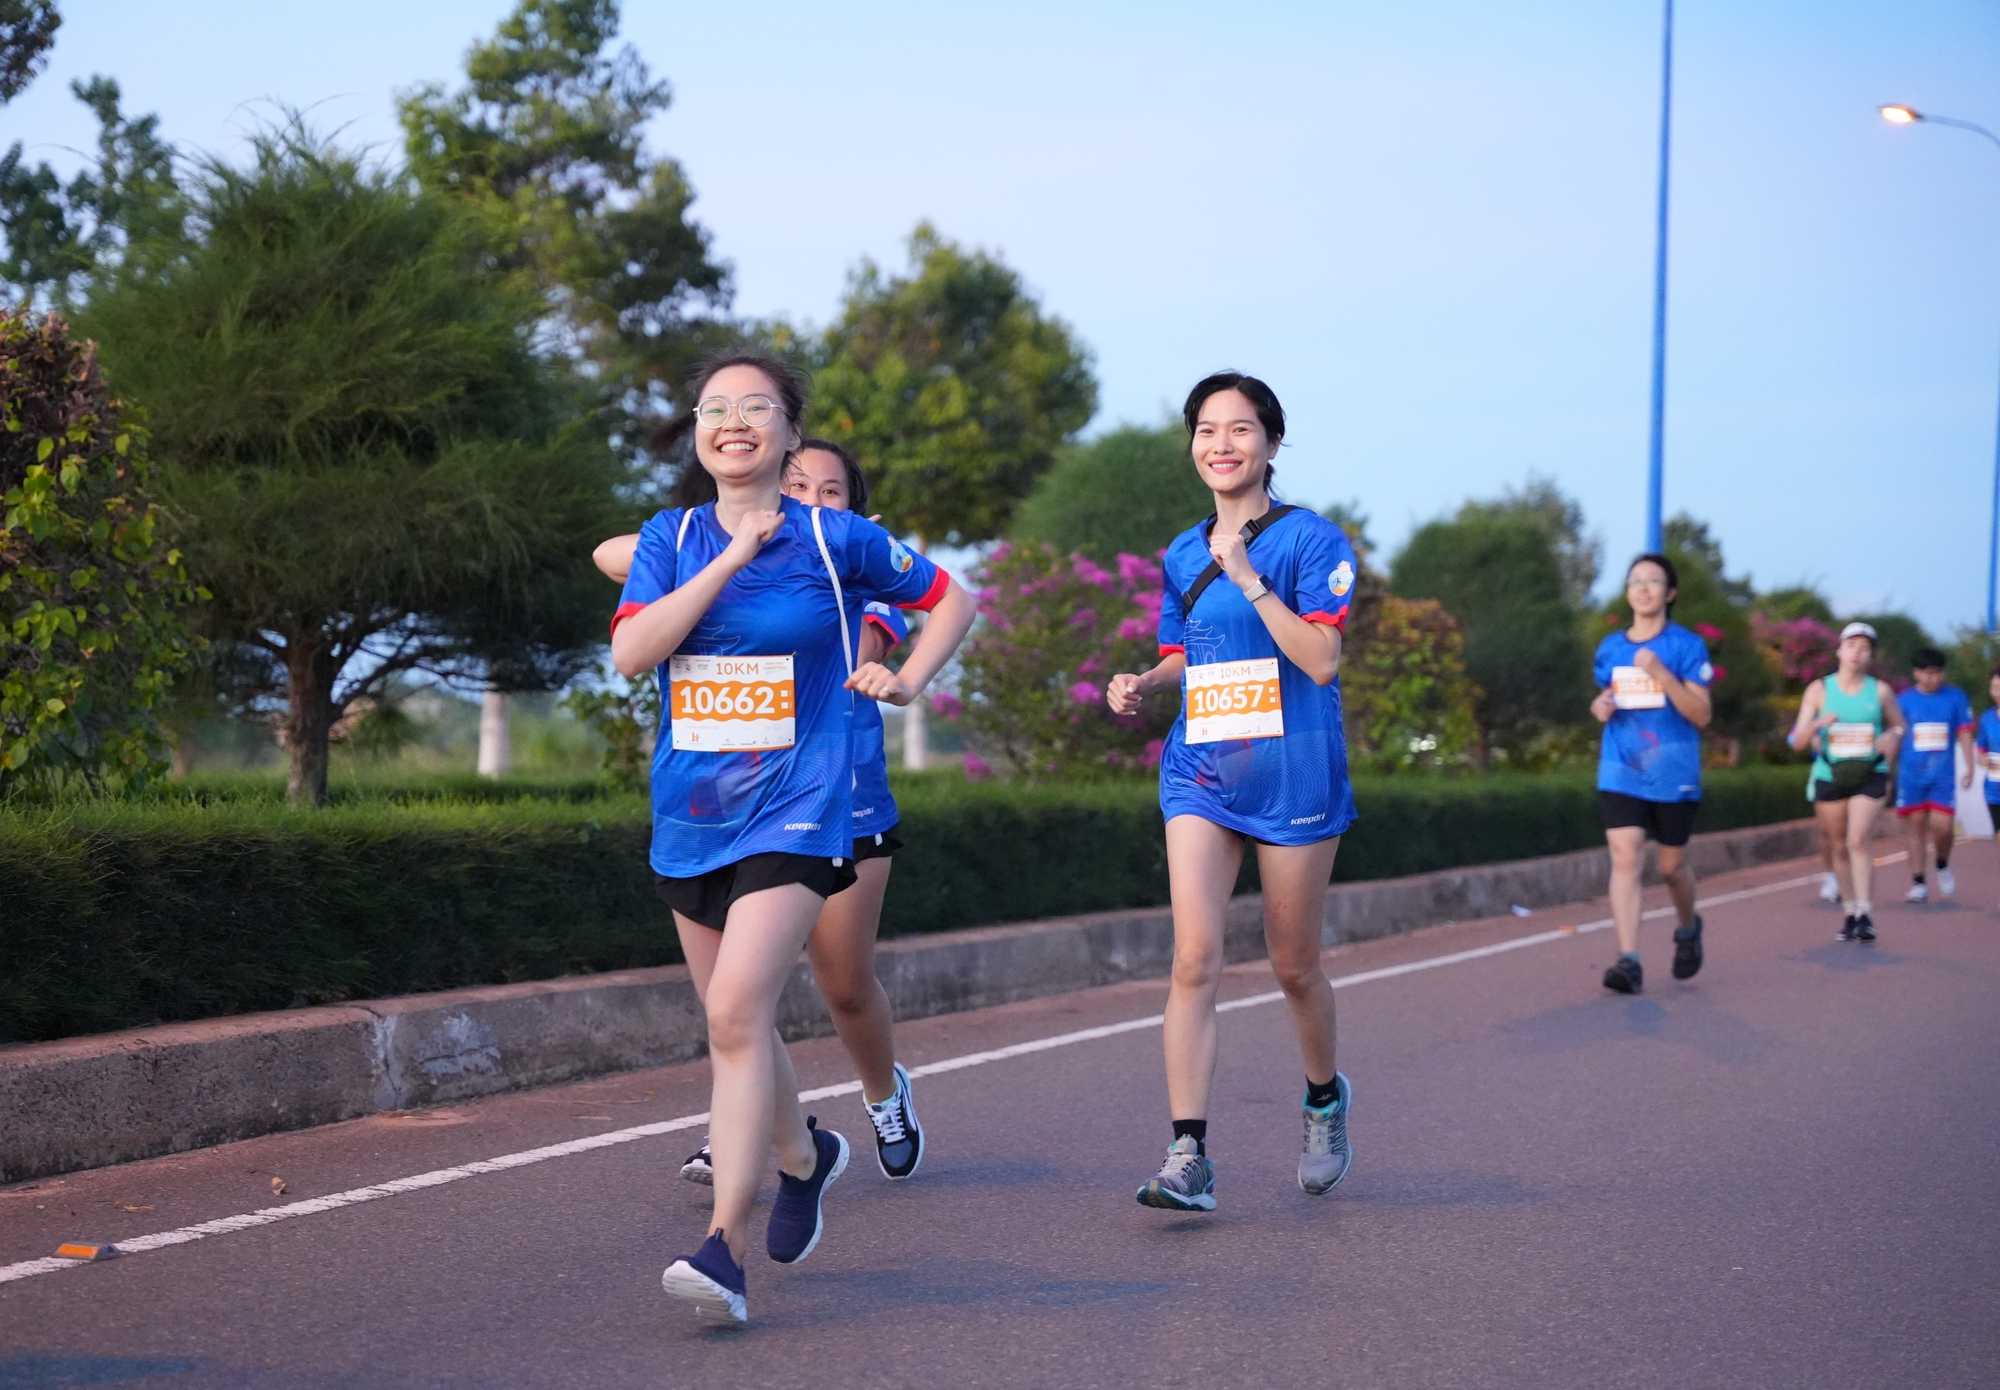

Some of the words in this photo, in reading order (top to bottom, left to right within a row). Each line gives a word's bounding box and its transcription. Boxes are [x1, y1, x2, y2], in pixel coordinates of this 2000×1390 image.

[716, 662, 760, 675] 10KM
[1220, 665, 1251, 679] 10KM
[679, 686, 775, 714] 10662
[1194, 684, 1264, 713] 10657
